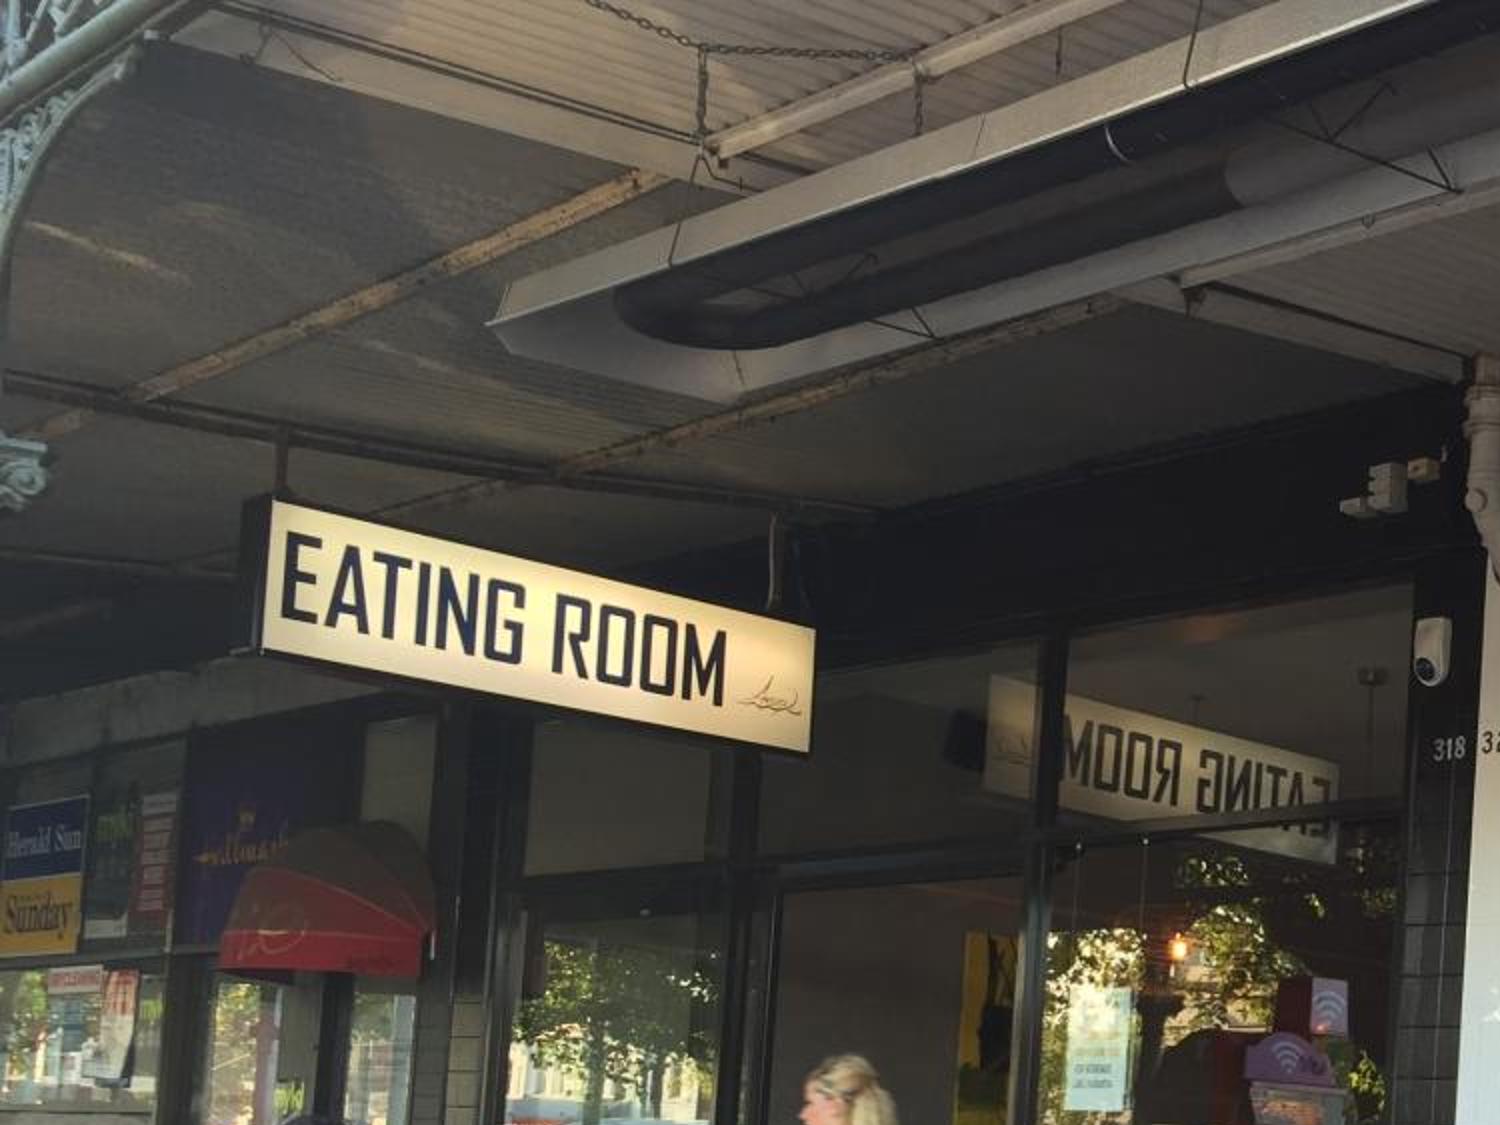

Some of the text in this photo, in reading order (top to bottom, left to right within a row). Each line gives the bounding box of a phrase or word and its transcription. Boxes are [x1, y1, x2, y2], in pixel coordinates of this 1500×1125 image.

[281, 531, 727, 707] EATING ROOM
[1433, 735, 1466, 762] 318
[3, 892, 73, 941] Sunday
